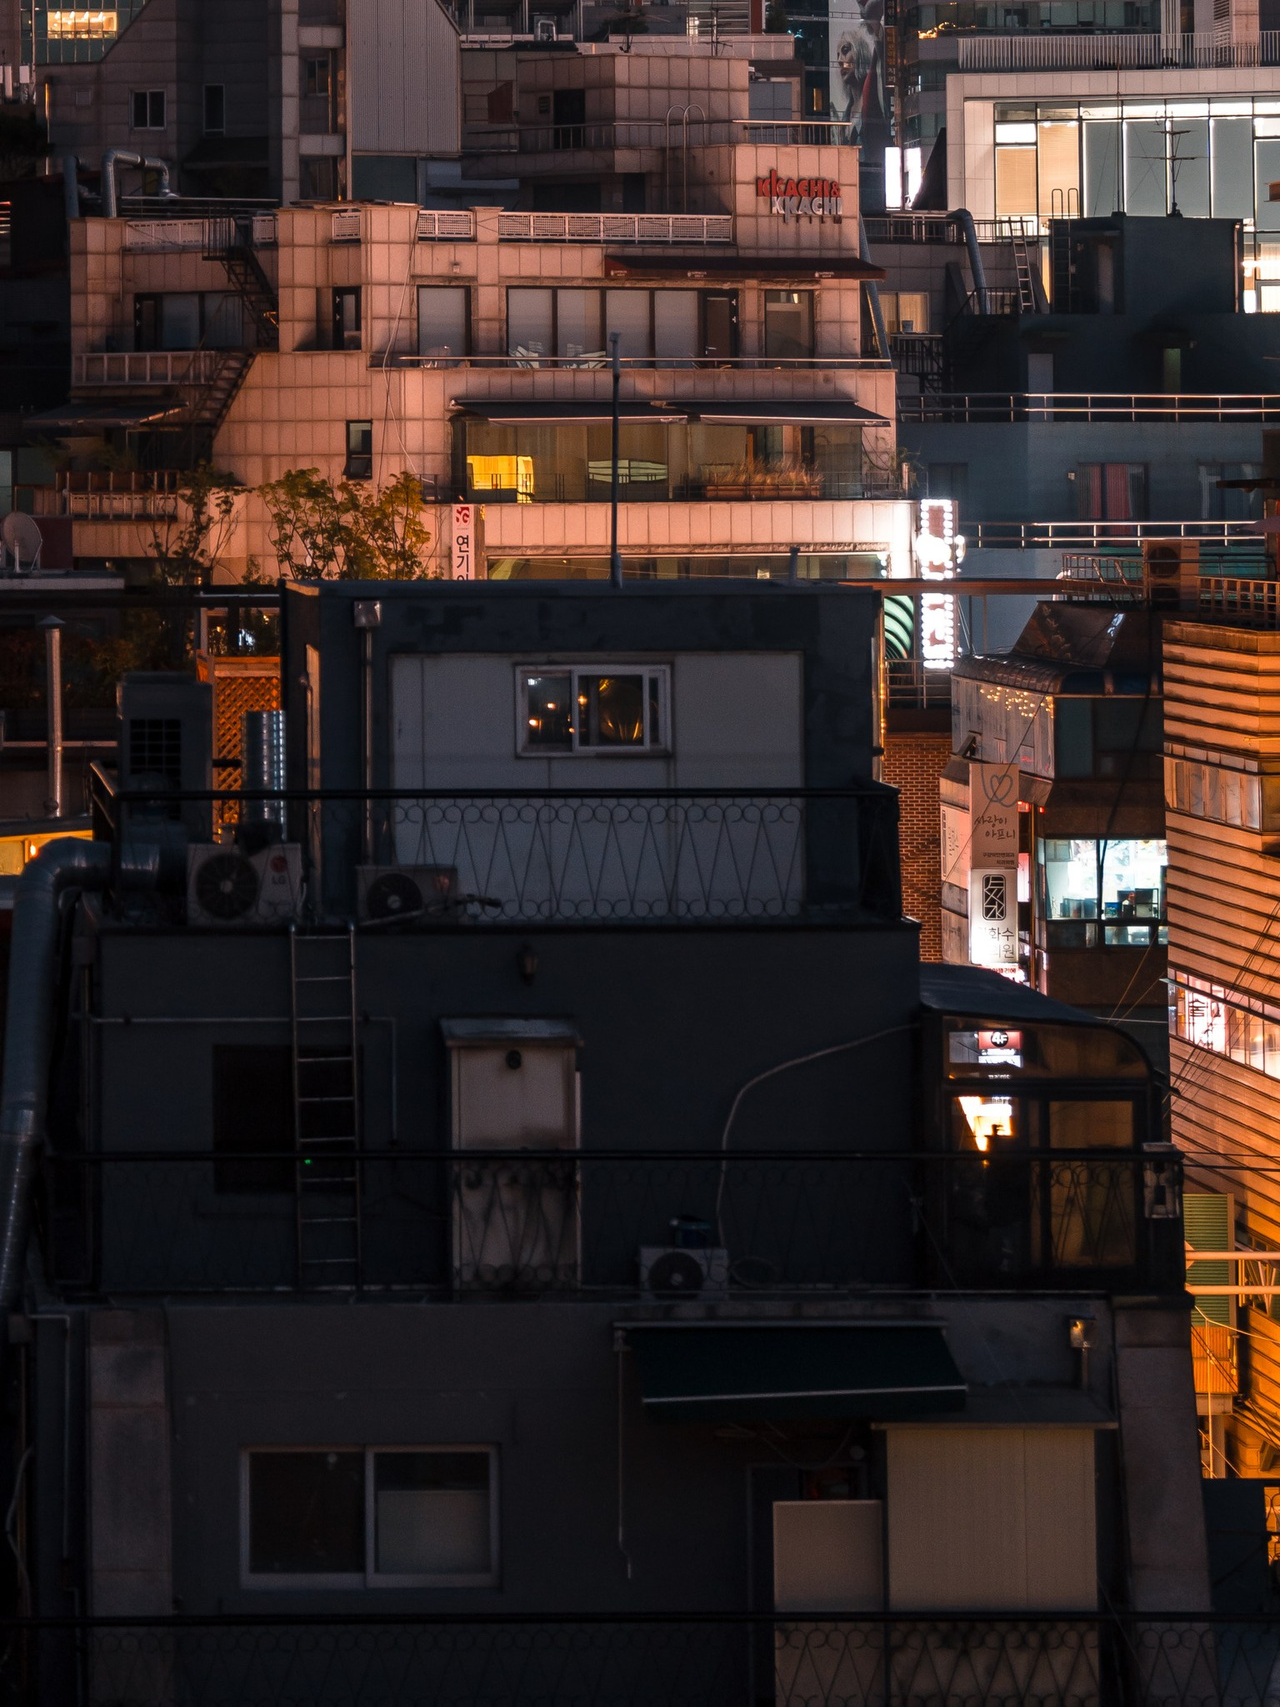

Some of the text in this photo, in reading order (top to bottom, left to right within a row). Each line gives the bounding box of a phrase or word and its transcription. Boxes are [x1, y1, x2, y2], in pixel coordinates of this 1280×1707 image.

[974, 814, 1008, 828] 사랑이
[985, 829, 1016, 840] 아프니
[272, 875, 286, 885] LG
[991, 1031, 1008, 1045] 4F
